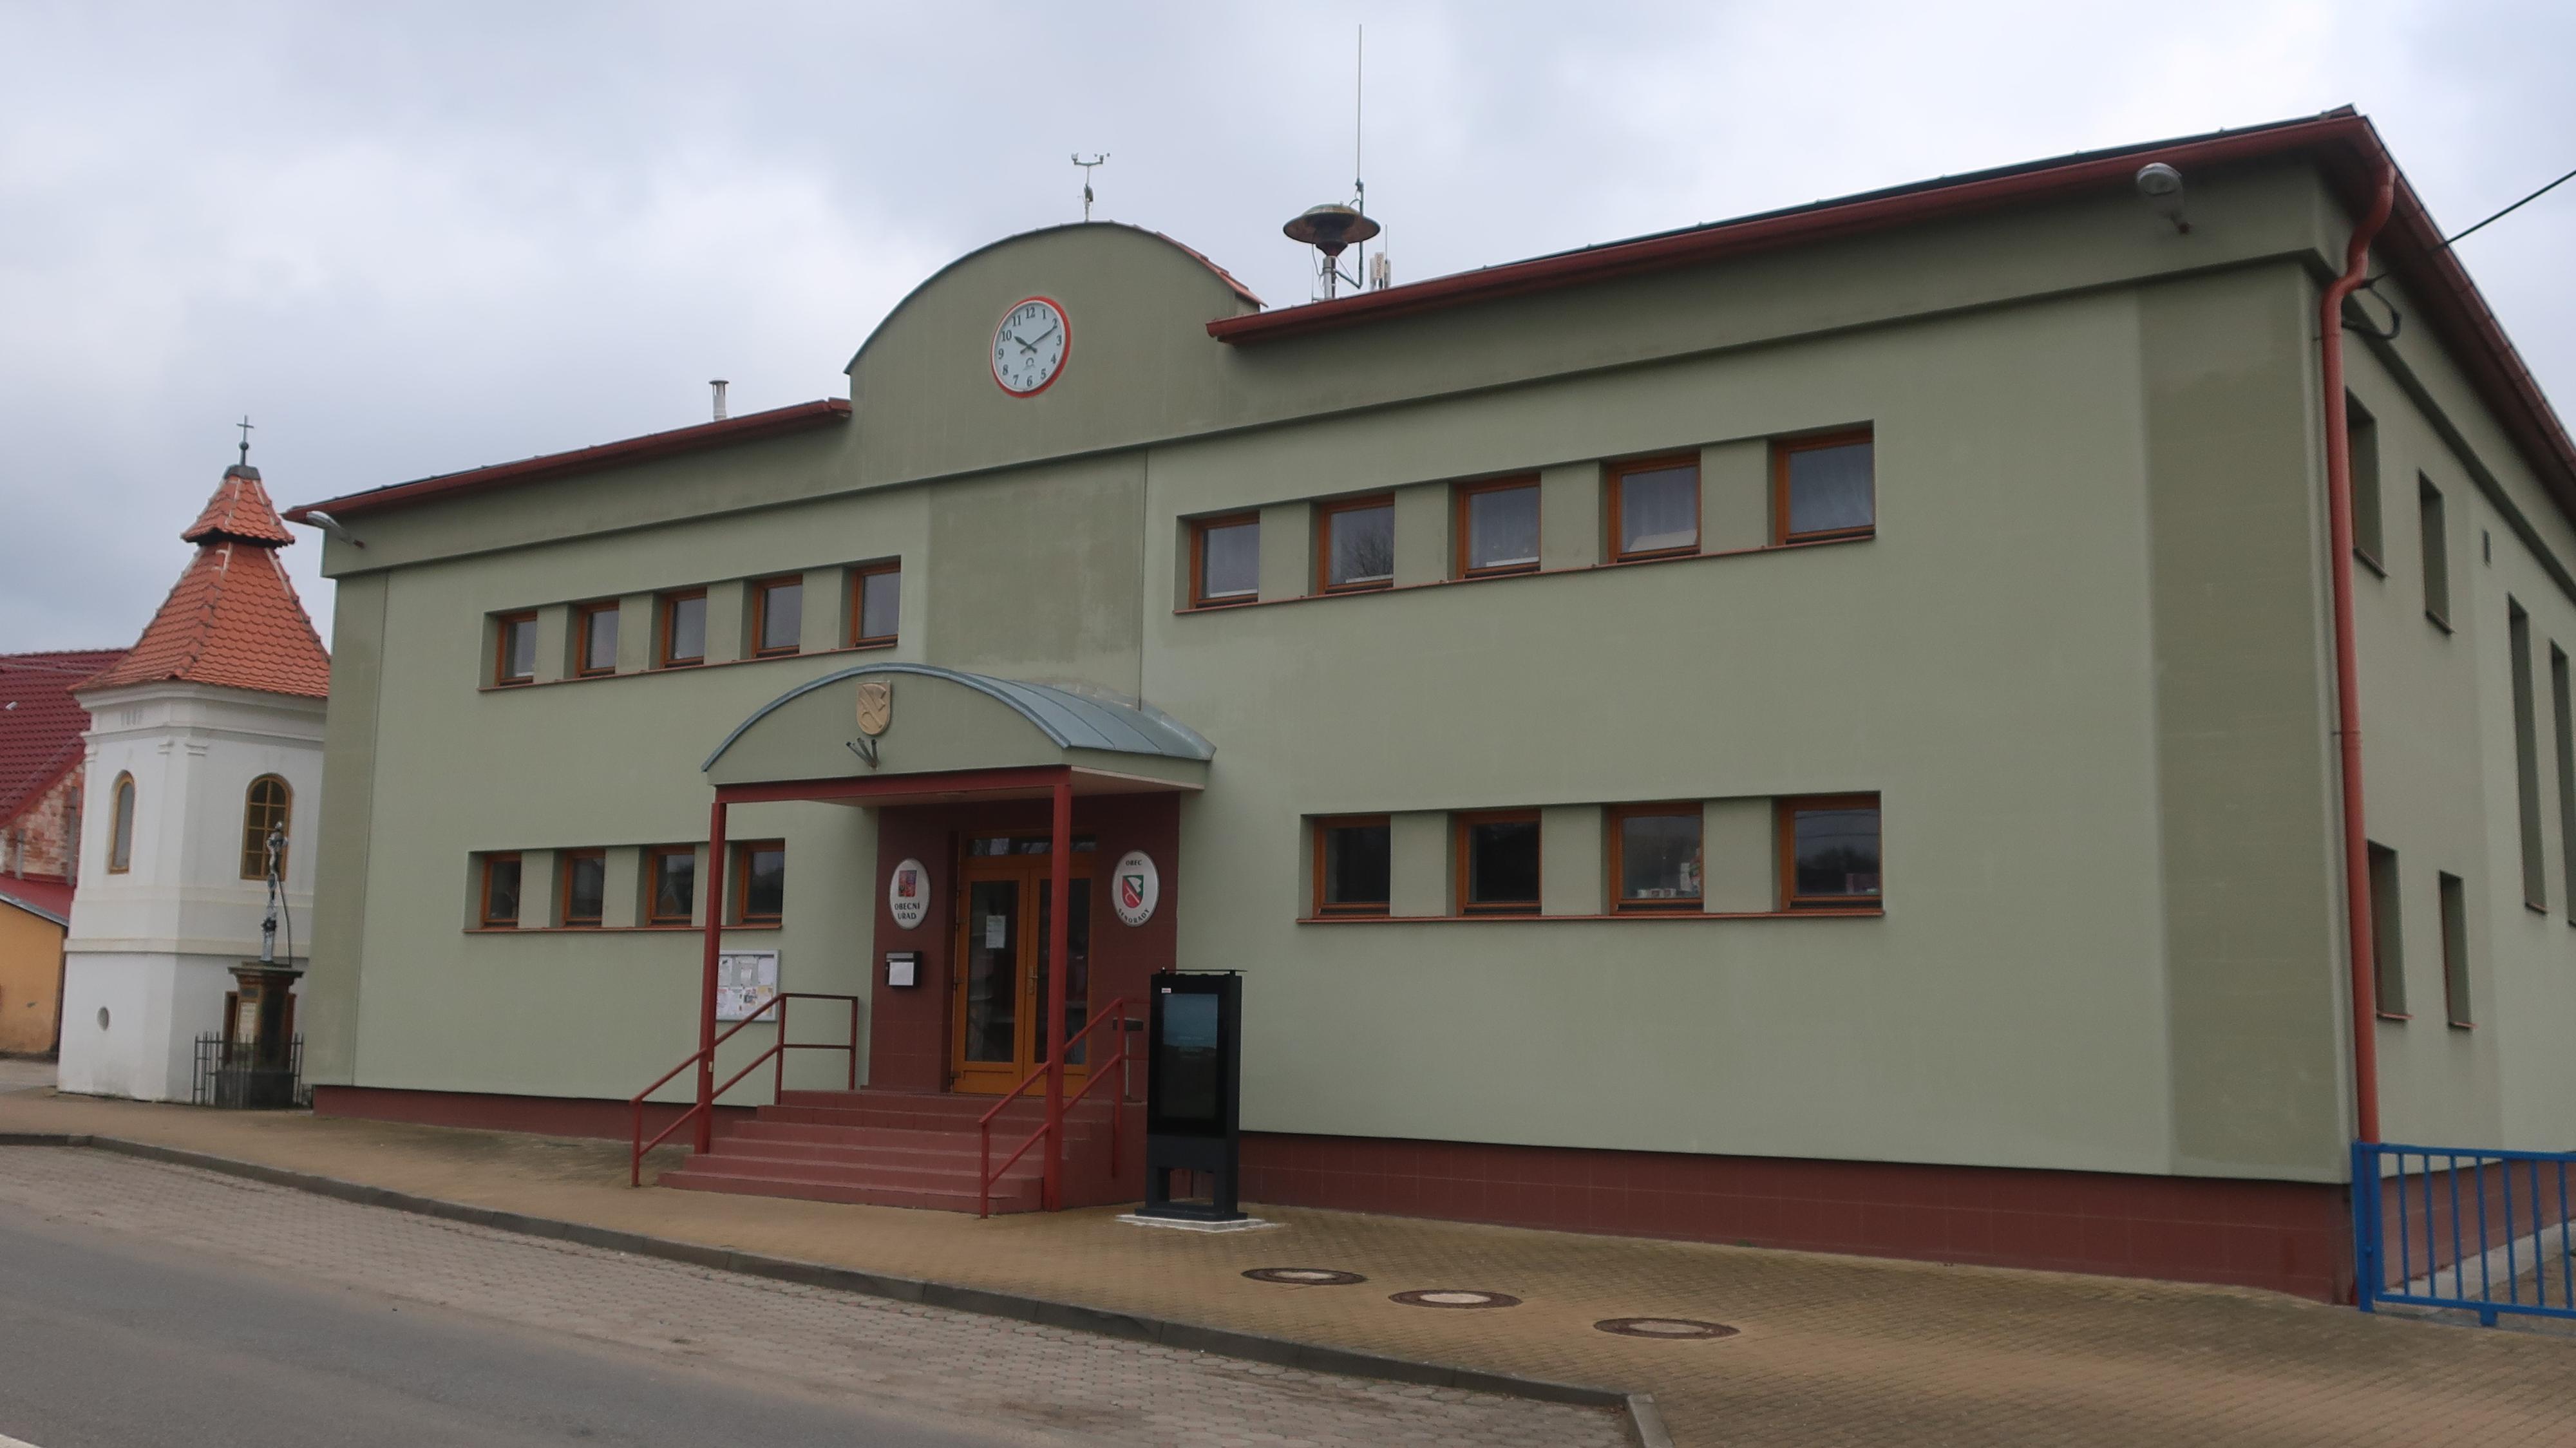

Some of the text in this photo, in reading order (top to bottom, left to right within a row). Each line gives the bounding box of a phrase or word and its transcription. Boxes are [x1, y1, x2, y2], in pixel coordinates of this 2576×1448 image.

[1026, 306, 1036, 319] 12
[1042, 308, 1046, 320] 1
[1012, 314, 1021, 326] 11
[1052, 318, 1058, 329] 2
[1001, 330, 1012, 342] 10
[1056, 334, 1062, 346] 3
[998, 348, 1005, 359] 9
[1050, 353, 1056, 364] 4
[1002, 364, 1009, 376] 8
[1040, 368, 1046, 380] 5
[1012, 374, 1019, 385] 7
[1027, 375, 1033, 387] 6
